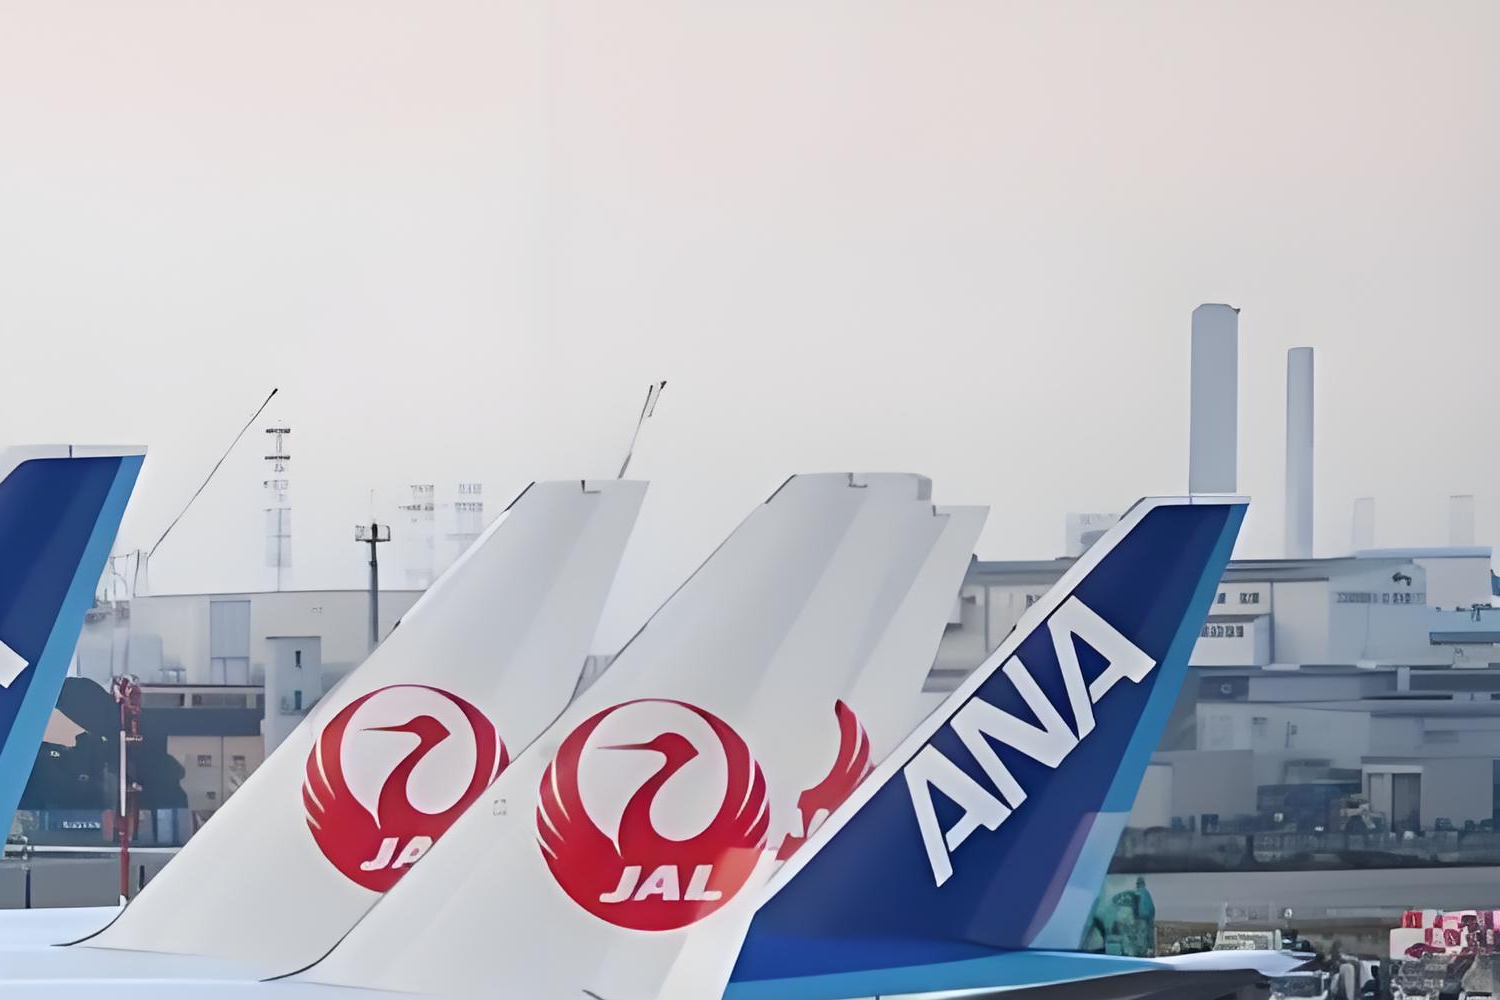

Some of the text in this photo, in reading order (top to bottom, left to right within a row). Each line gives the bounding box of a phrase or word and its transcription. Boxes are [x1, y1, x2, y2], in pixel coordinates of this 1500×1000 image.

[903, 594, 1157, 887] ANA
[360, 836, 433, 871] JA
[599, 864, 723, 903] JAL
